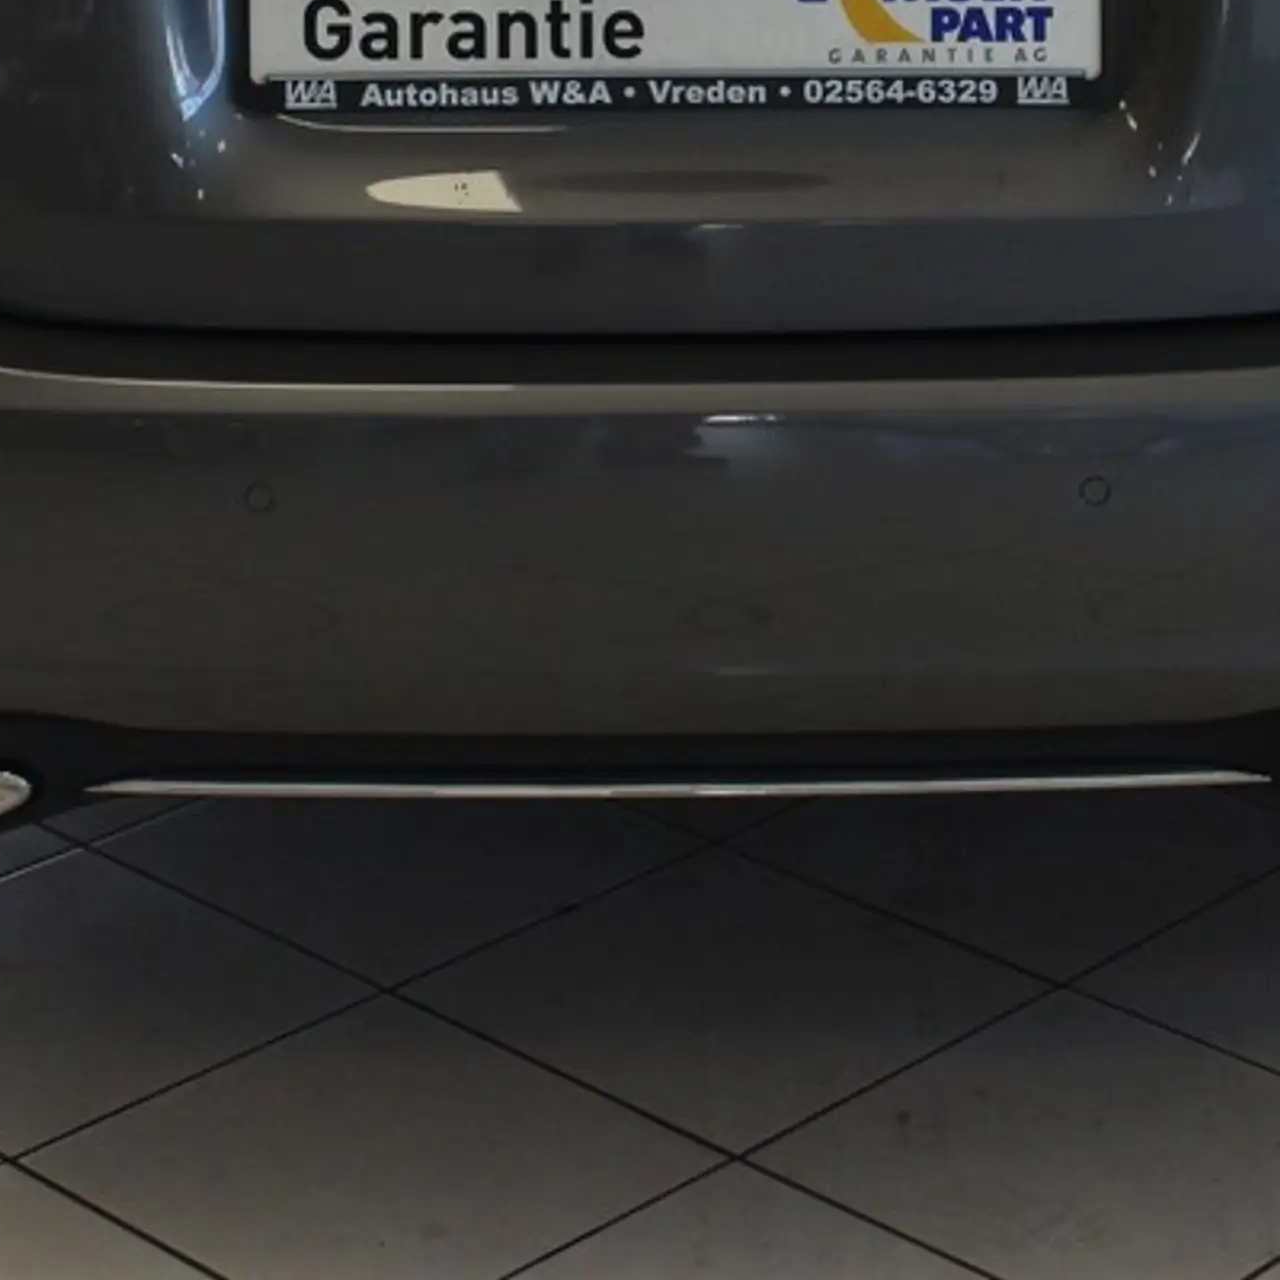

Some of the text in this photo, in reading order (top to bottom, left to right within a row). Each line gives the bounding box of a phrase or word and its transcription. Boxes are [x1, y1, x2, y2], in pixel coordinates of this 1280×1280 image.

[930, 6, 1054, 43] PART
[828, 47, 1048, 65] GARANTIE AG
[360, 81, 519, 108] Autohaus
[528, 80, 613, 105] W&A
[646, 79, 767, 104] Vreden
[803, 78, 999, 105] 02564-6329
